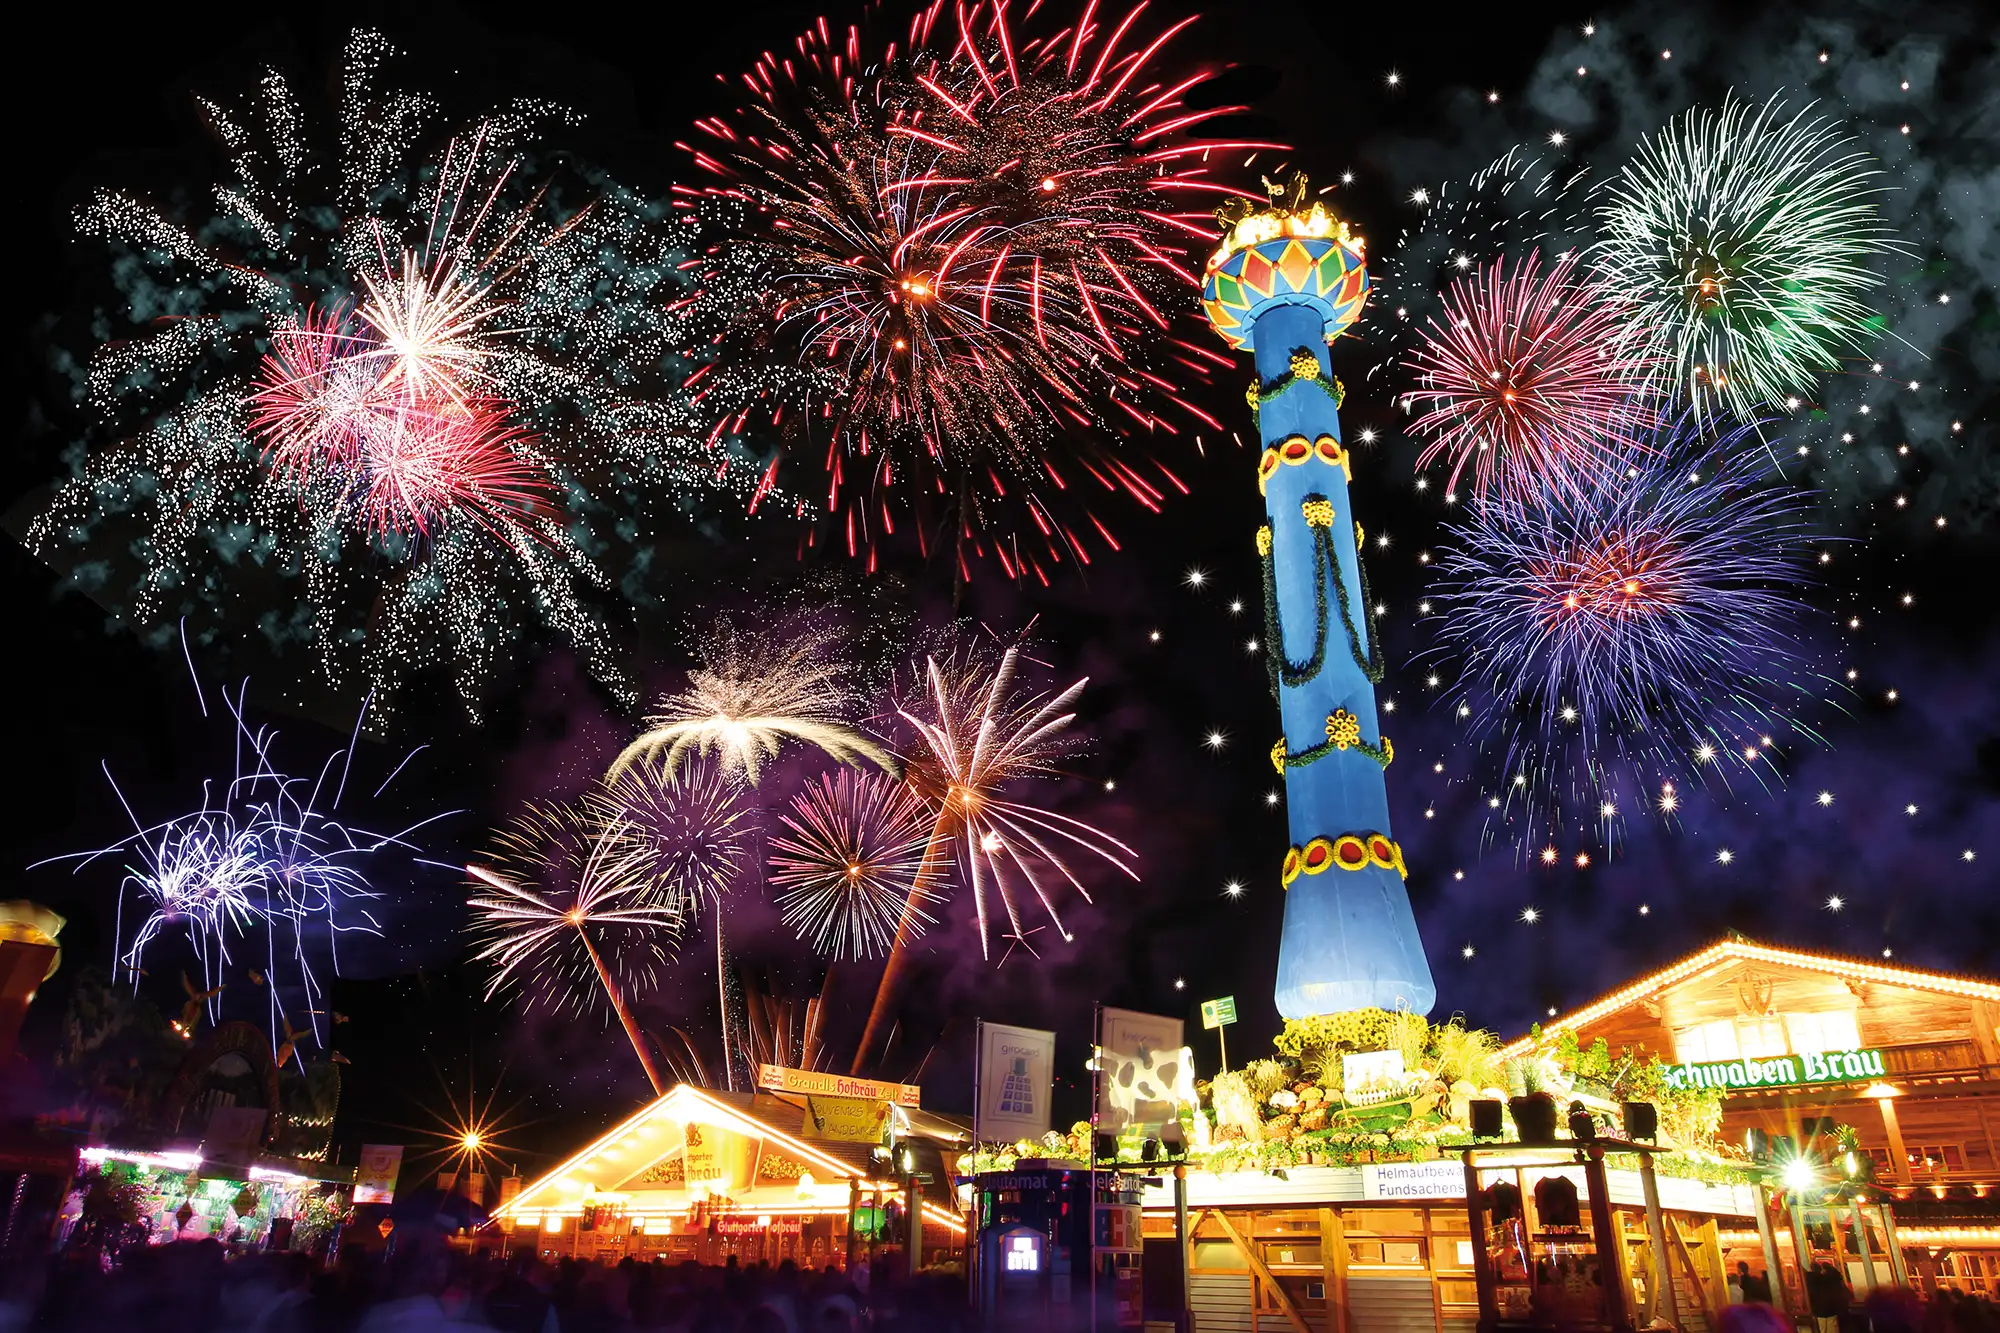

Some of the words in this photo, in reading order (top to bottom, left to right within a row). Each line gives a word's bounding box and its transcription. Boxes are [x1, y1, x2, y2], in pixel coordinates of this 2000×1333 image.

[1659, 1056, 1798, 1091] Schwaben
[1799, 1048, 1885, 1082] Bräu
[787, 1074, 835, 1092] Grandls
[836, 1079, 877, 1098] Hofbräu
[769, 1220, 801, 1236] ofbräu
